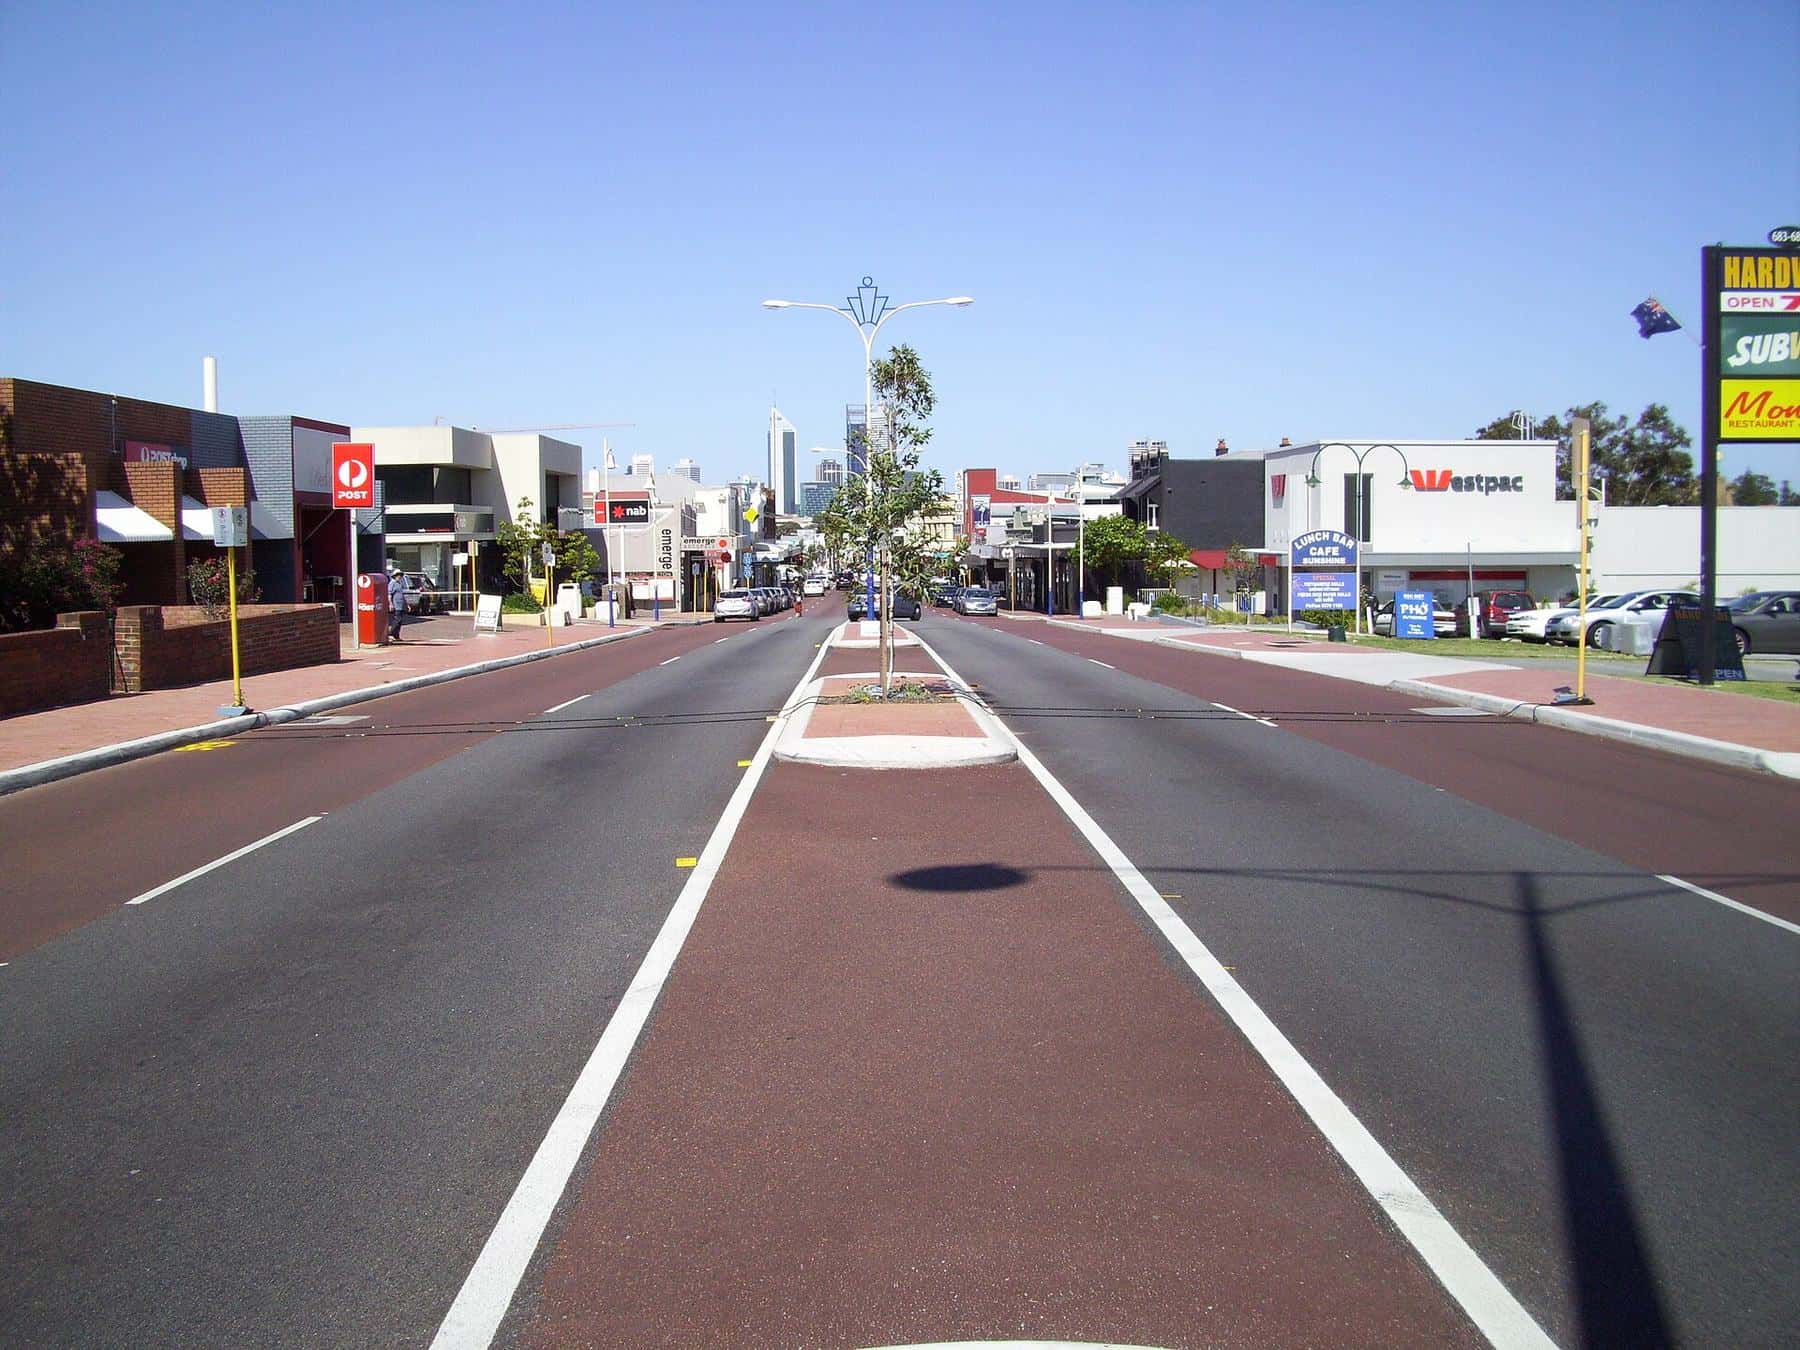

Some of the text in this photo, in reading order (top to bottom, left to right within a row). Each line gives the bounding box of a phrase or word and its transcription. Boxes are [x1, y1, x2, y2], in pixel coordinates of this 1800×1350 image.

[1727, 297, 1774, 308] OPEN
[1728, 420, 1793, 428] RESTAURANT
[1409, 470, 1523, 496] Westpac
[338, 490, 368, 500] POST
[626, 505, 647, 516] nab
[684, 537, 716, 545] emerge
[1294, 531, 1330, 550] LUNCH
[1332, 533, 1355, 549] BAR
[659, 528, 672, 570] emerge
[1309, 546, 1340, 556] CAFE
[1713, 669, 1744, 679] PEN
